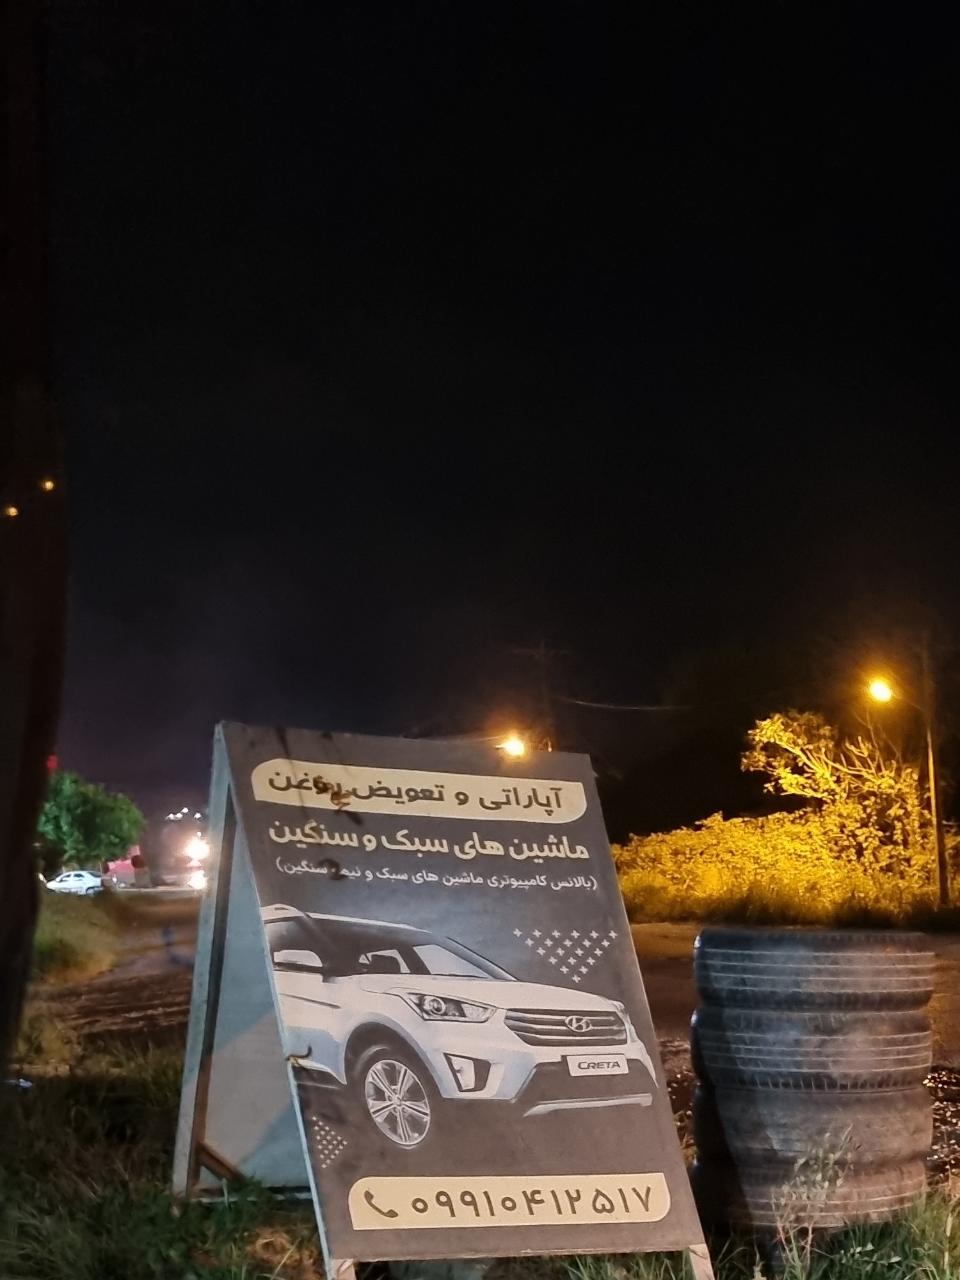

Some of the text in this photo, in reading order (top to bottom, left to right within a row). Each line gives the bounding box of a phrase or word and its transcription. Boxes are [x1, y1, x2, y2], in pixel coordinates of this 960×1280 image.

[350, 780, 445, 804] تعویض
[454, 790, 470, 806] و
[478, 787, 563, 816] آپاراتی
[268, 819, 590, 864] ماشین های سبک و سنگین
[365, 870, 374, 882] و
[375, 867, 408, 883] سبک
[411, 869, 439, 884] های
[442, 872, 484, 887] ماشین
[486, 875, 548, 891] کامپیوتری
[577, 1060, 621, 1070] CRETA
[411, 1186, 652, 1218] ۰۹۹۱۰۴۱۲۵۱۷
